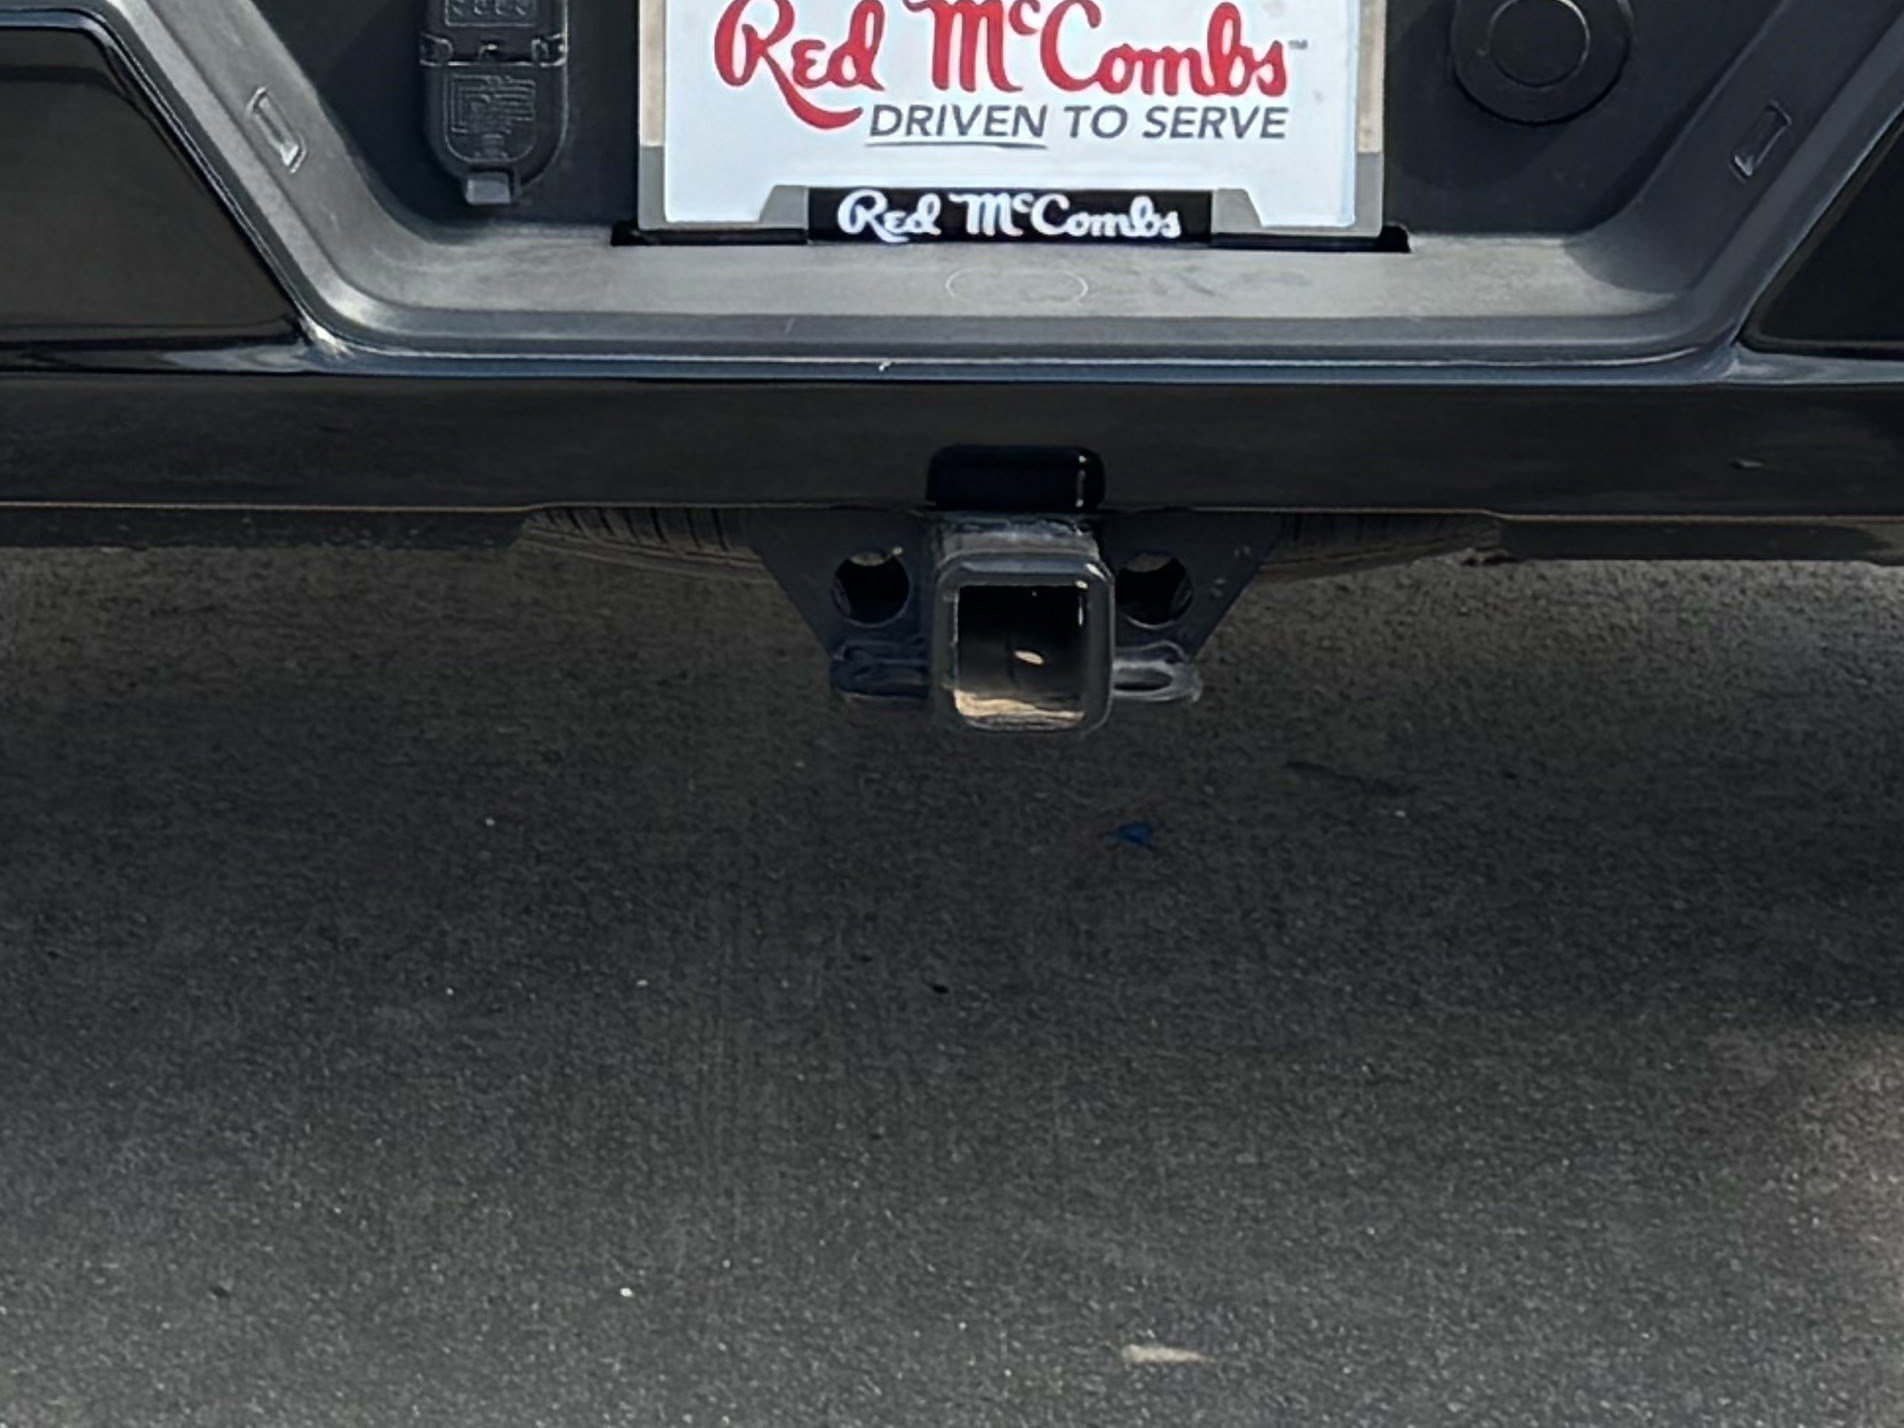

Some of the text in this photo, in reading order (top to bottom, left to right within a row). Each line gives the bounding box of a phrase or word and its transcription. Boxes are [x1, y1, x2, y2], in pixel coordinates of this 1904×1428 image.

[869, 103, 1290, 141] DRIVEN TO SERVE
[837, 189, 1182, 243] Red McCombs
